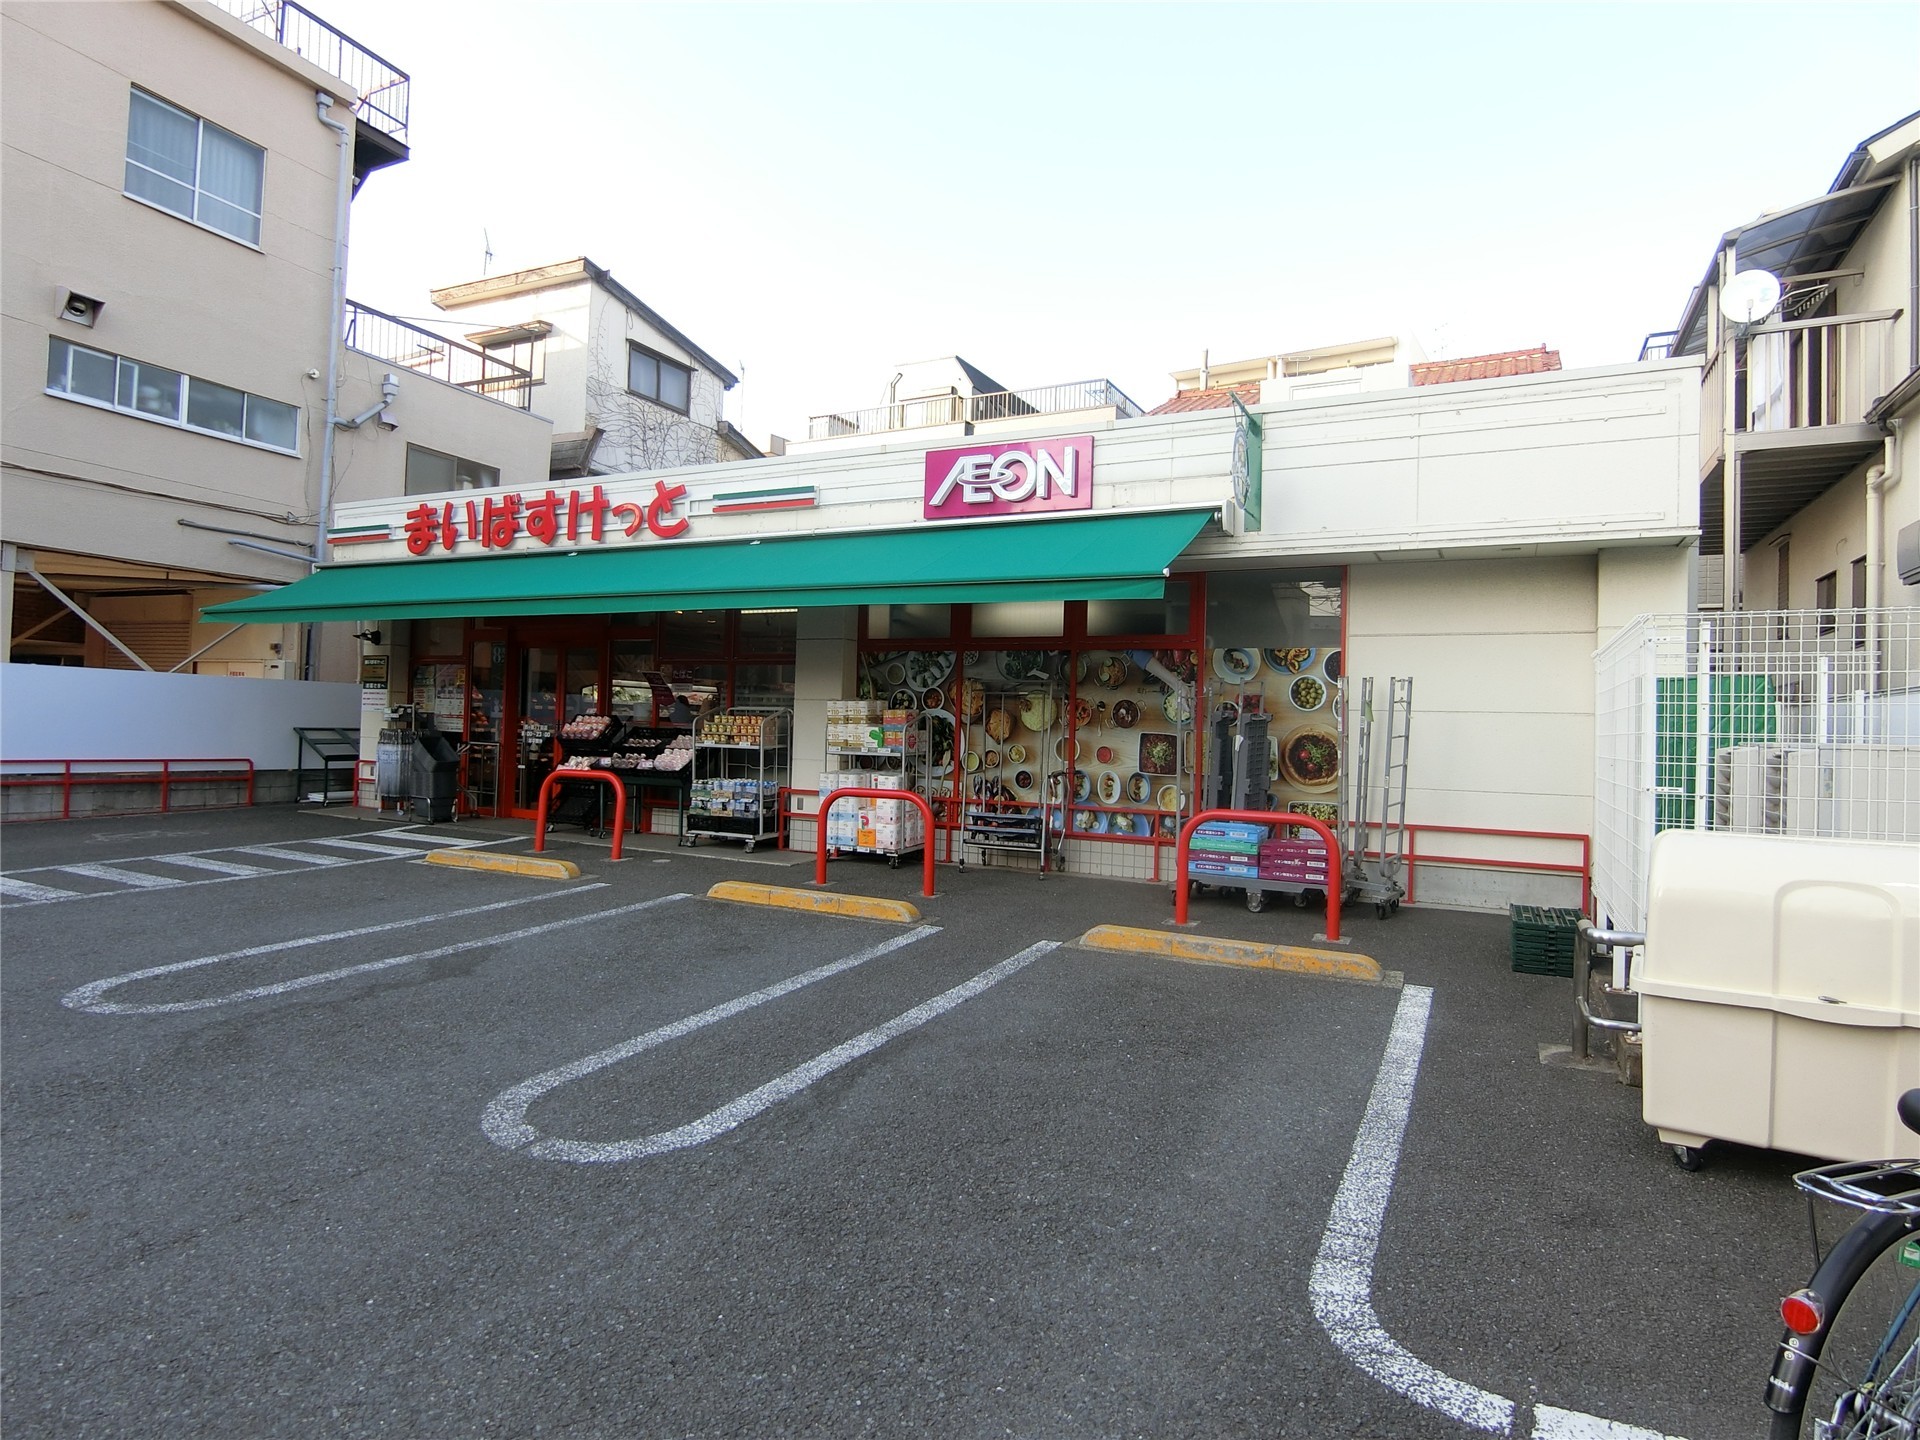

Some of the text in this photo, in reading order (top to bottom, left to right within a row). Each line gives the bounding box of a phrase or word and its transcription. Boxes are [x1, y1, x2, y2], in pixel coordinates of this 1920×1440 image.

[404, 479, 690, 556] まいばすけっと
